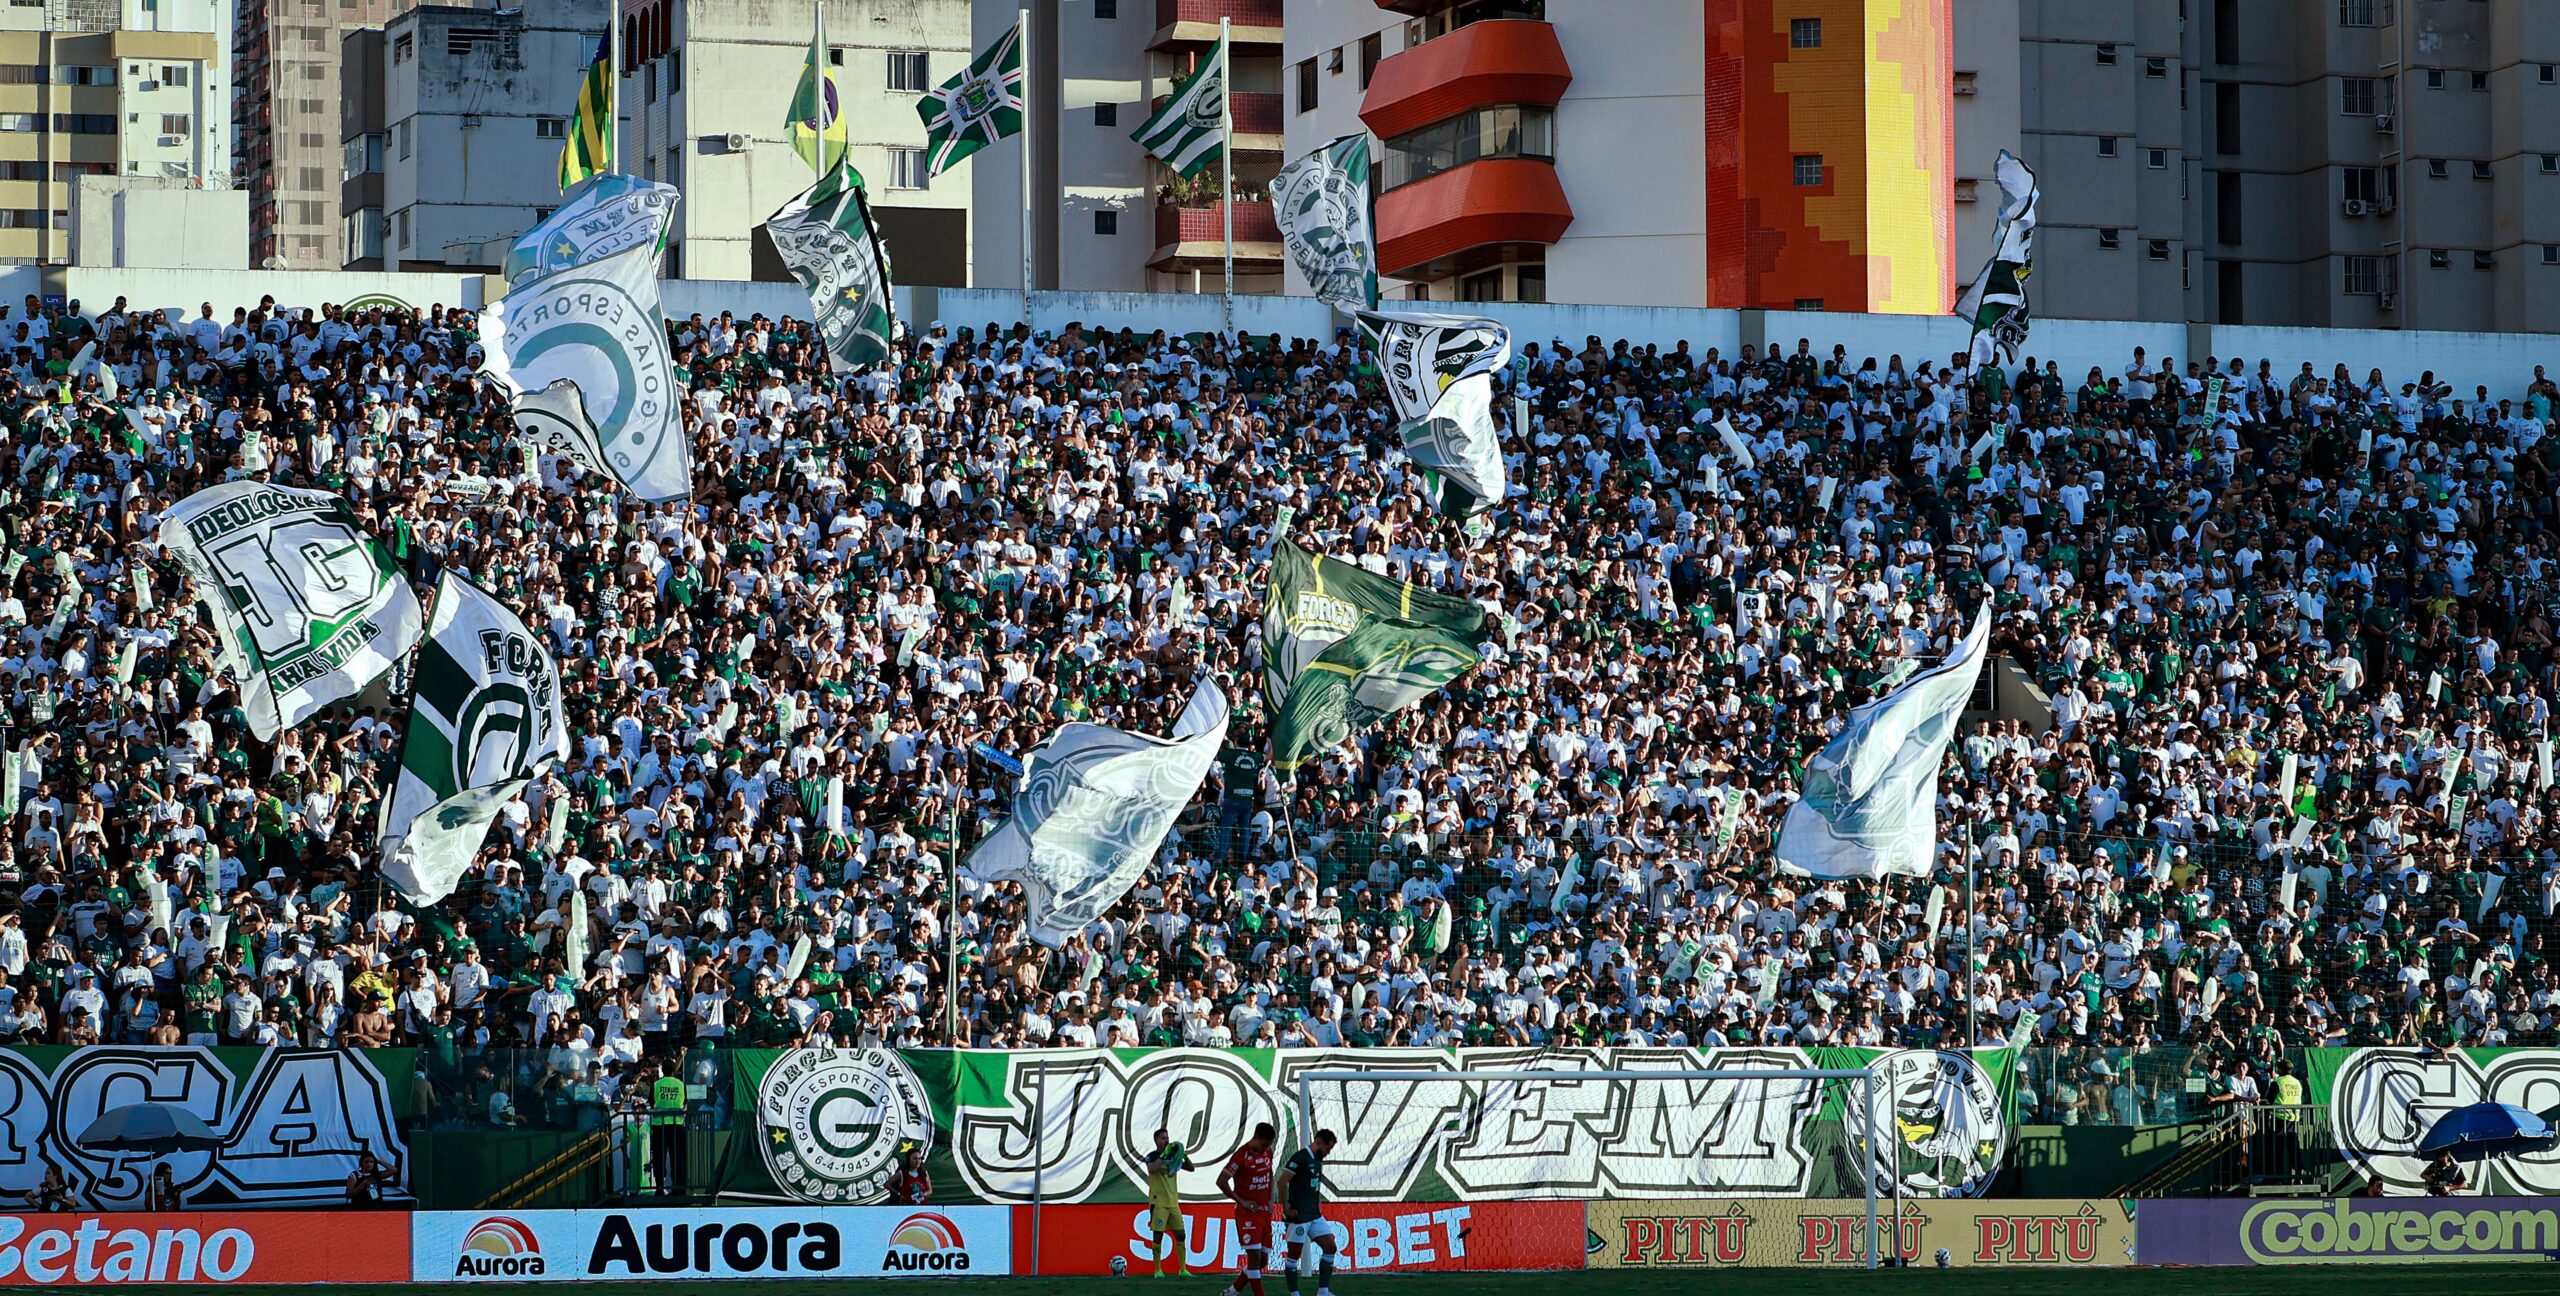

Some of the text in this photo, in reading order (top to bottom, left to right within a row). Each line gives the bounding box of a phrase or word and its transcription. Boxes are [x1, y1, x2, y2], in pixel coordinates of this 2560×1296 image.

[1743, 597, 1759, 610] 43
[313, 614, 381, 671] VIDA
[769, 1044, 922, 1127] FORÇA JOVEM
[795, 1072, 896, 1147] GOIÁS ESPORTE CLUBE
[953, 1048, 1814, 1204] JOVEM
[814, 1155, 871, 1174] 6-4-1943
[586, 1214, 841, 1274] Aurora
[1620, 1202, 1751, 1264] PITÚ
[1799, 1202, 1928, 1264] PITÚ
[1973, 1201, 2102, 1263] PITÚ
[2261, 1197, 2559, 1252] cobrecom
[455, 1253, 545, 1277] Aurora
[882, 1249, 970, 1272] Aurora
